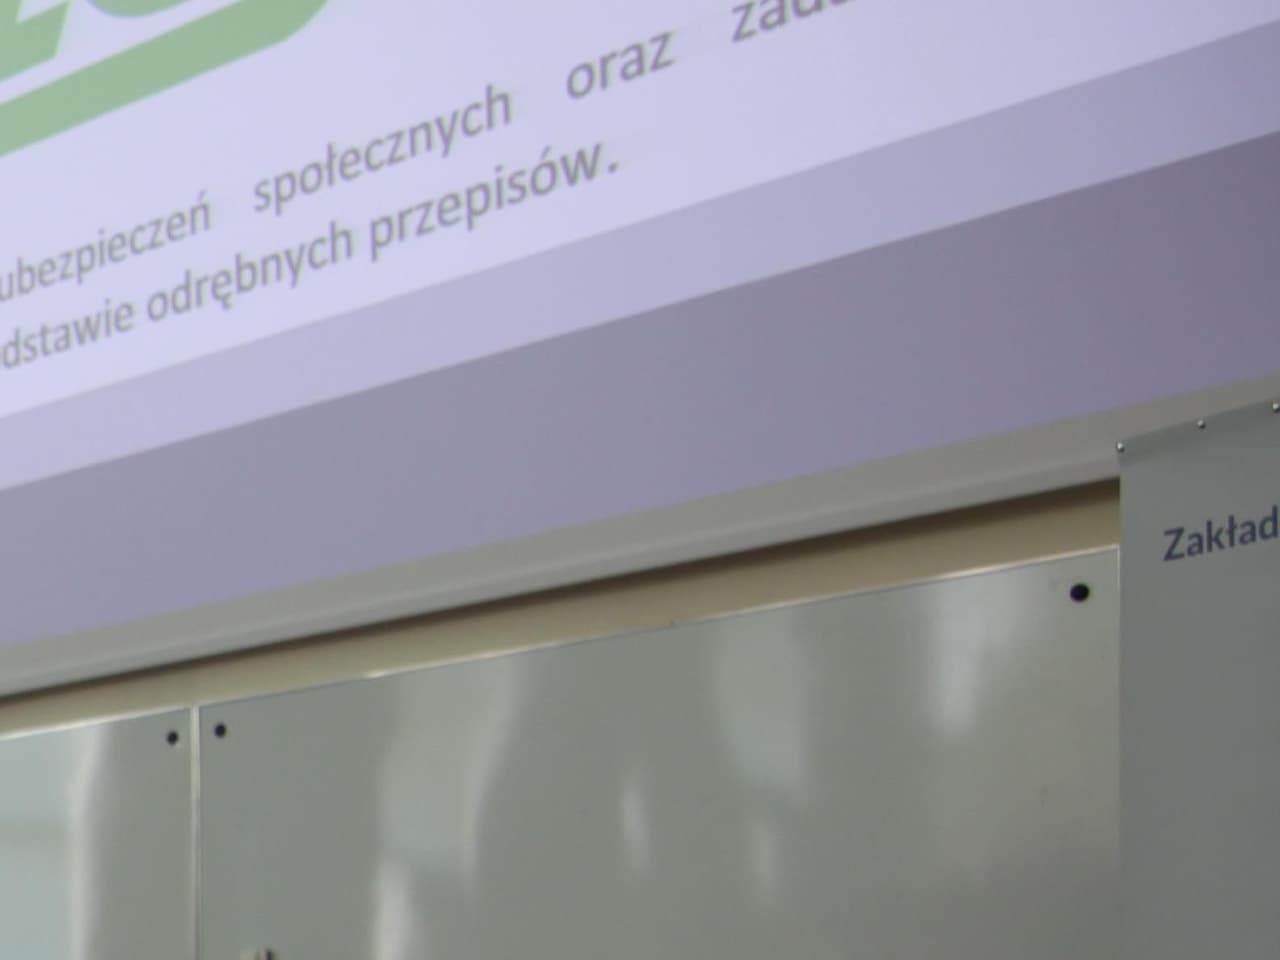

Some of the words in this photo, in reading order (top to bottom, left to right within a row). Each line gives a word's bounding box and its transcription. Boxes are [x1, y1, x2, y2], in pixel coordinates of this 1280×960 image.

[254, 84, 514, 214] społecznych
[566, 32, 678, 102] oraz
[146, 220, 356, 324] odrębnych
[370, 142, 621, 265] przepisów.
[1163, 504, 1280, 563] Zakład
